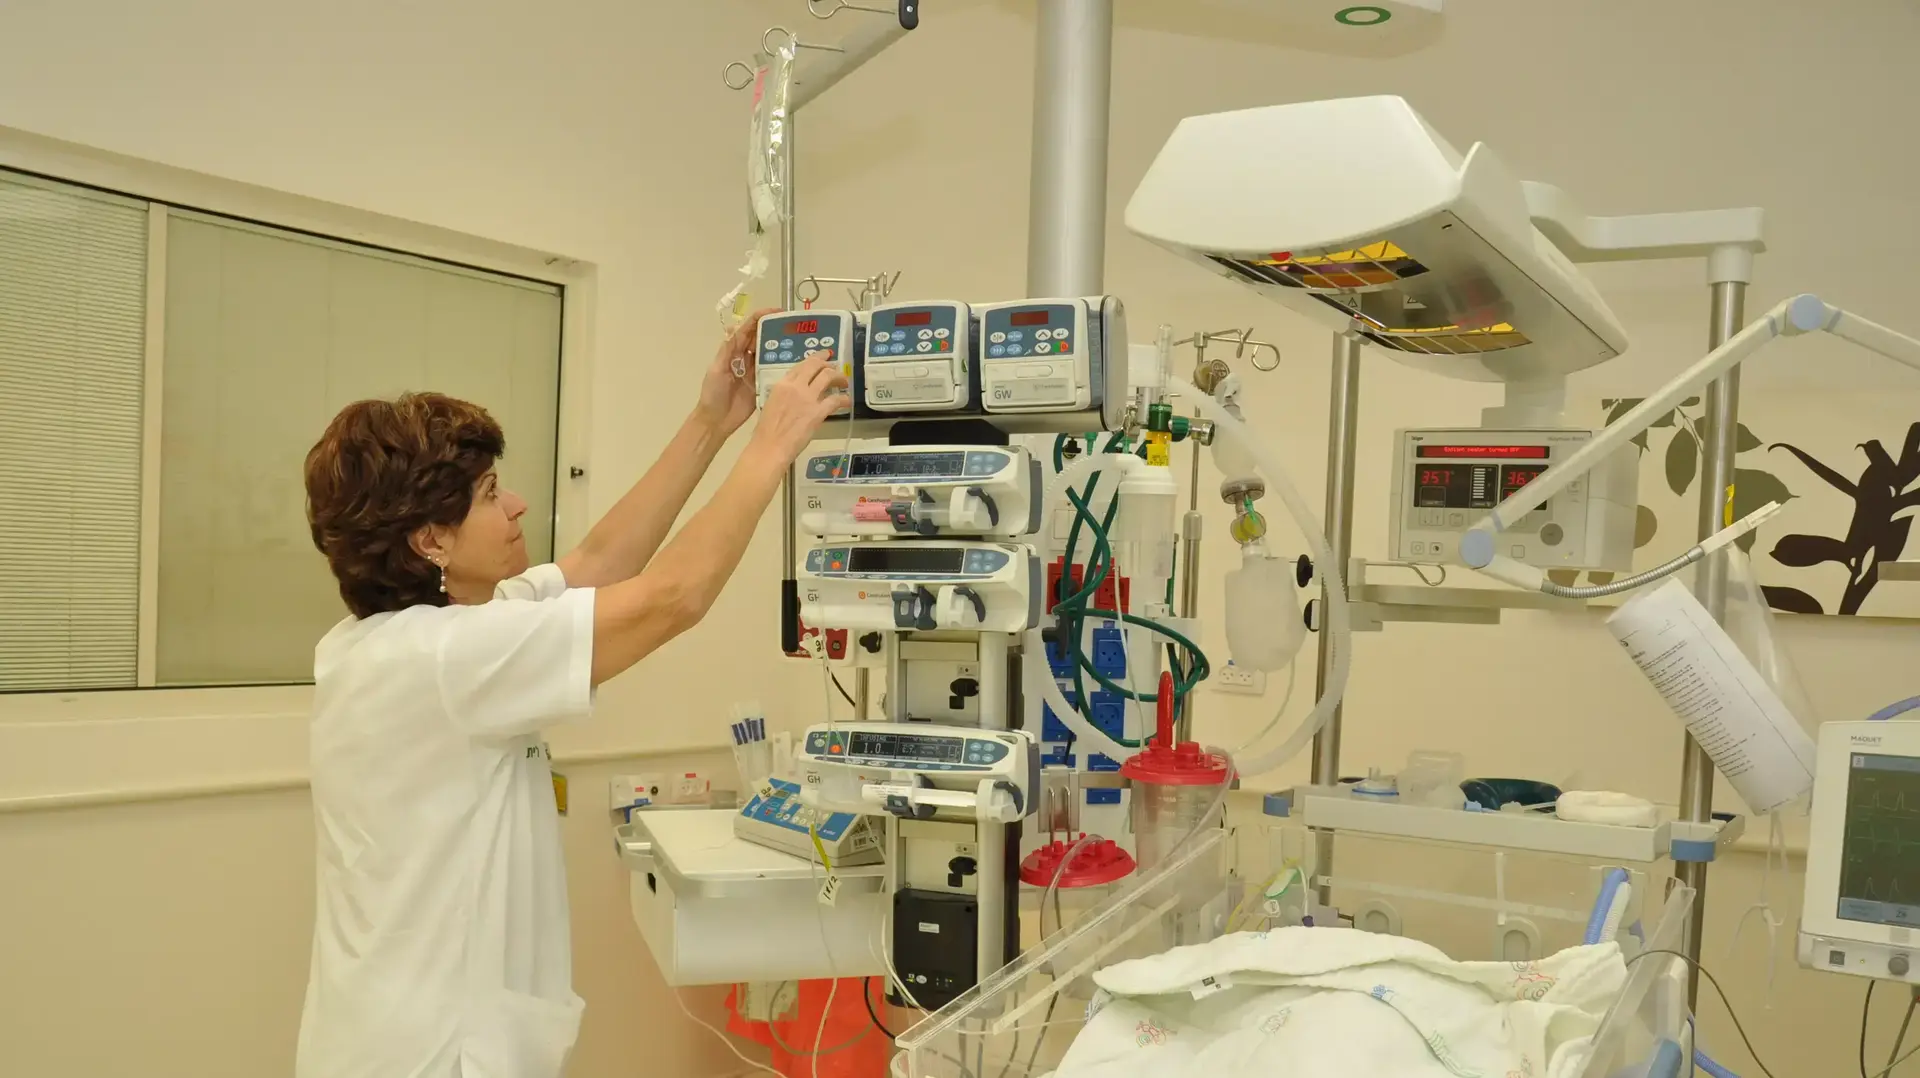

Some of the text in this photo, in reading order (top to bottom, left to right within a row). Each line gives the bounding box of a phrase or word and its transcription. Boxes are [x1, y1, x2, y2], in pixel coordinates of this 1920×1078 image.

[796, 320, 817, 333] 100
[875, 389, 893, 399] GW
[994, 389, 1012, 399] GW
[807, 500, 822, 509] GH
[807, 593, 820, 602] GH
[863, 742, 882, 754] 1.0
[807, 775, 821, 784] GH
